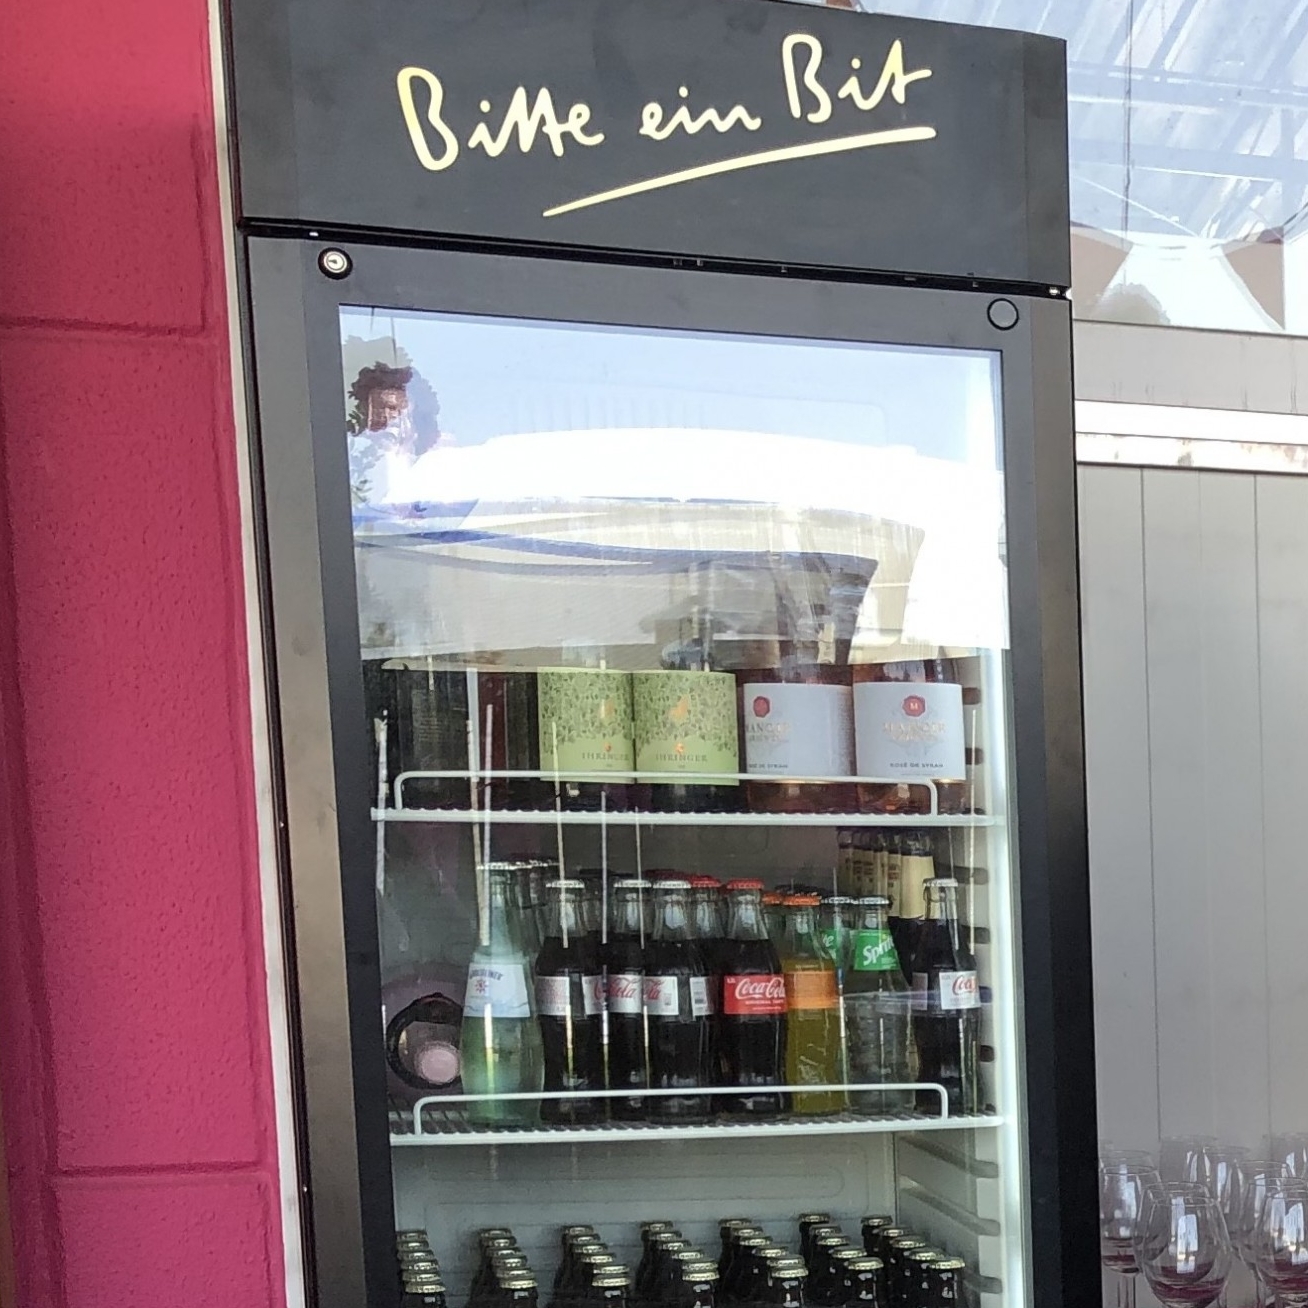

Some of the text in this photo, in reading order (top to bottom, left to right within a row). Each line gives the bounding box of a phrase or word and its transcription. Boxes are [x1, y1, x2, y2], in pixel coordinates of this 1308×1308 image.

[397, 33, 932, 171] Bitte ein Bit
